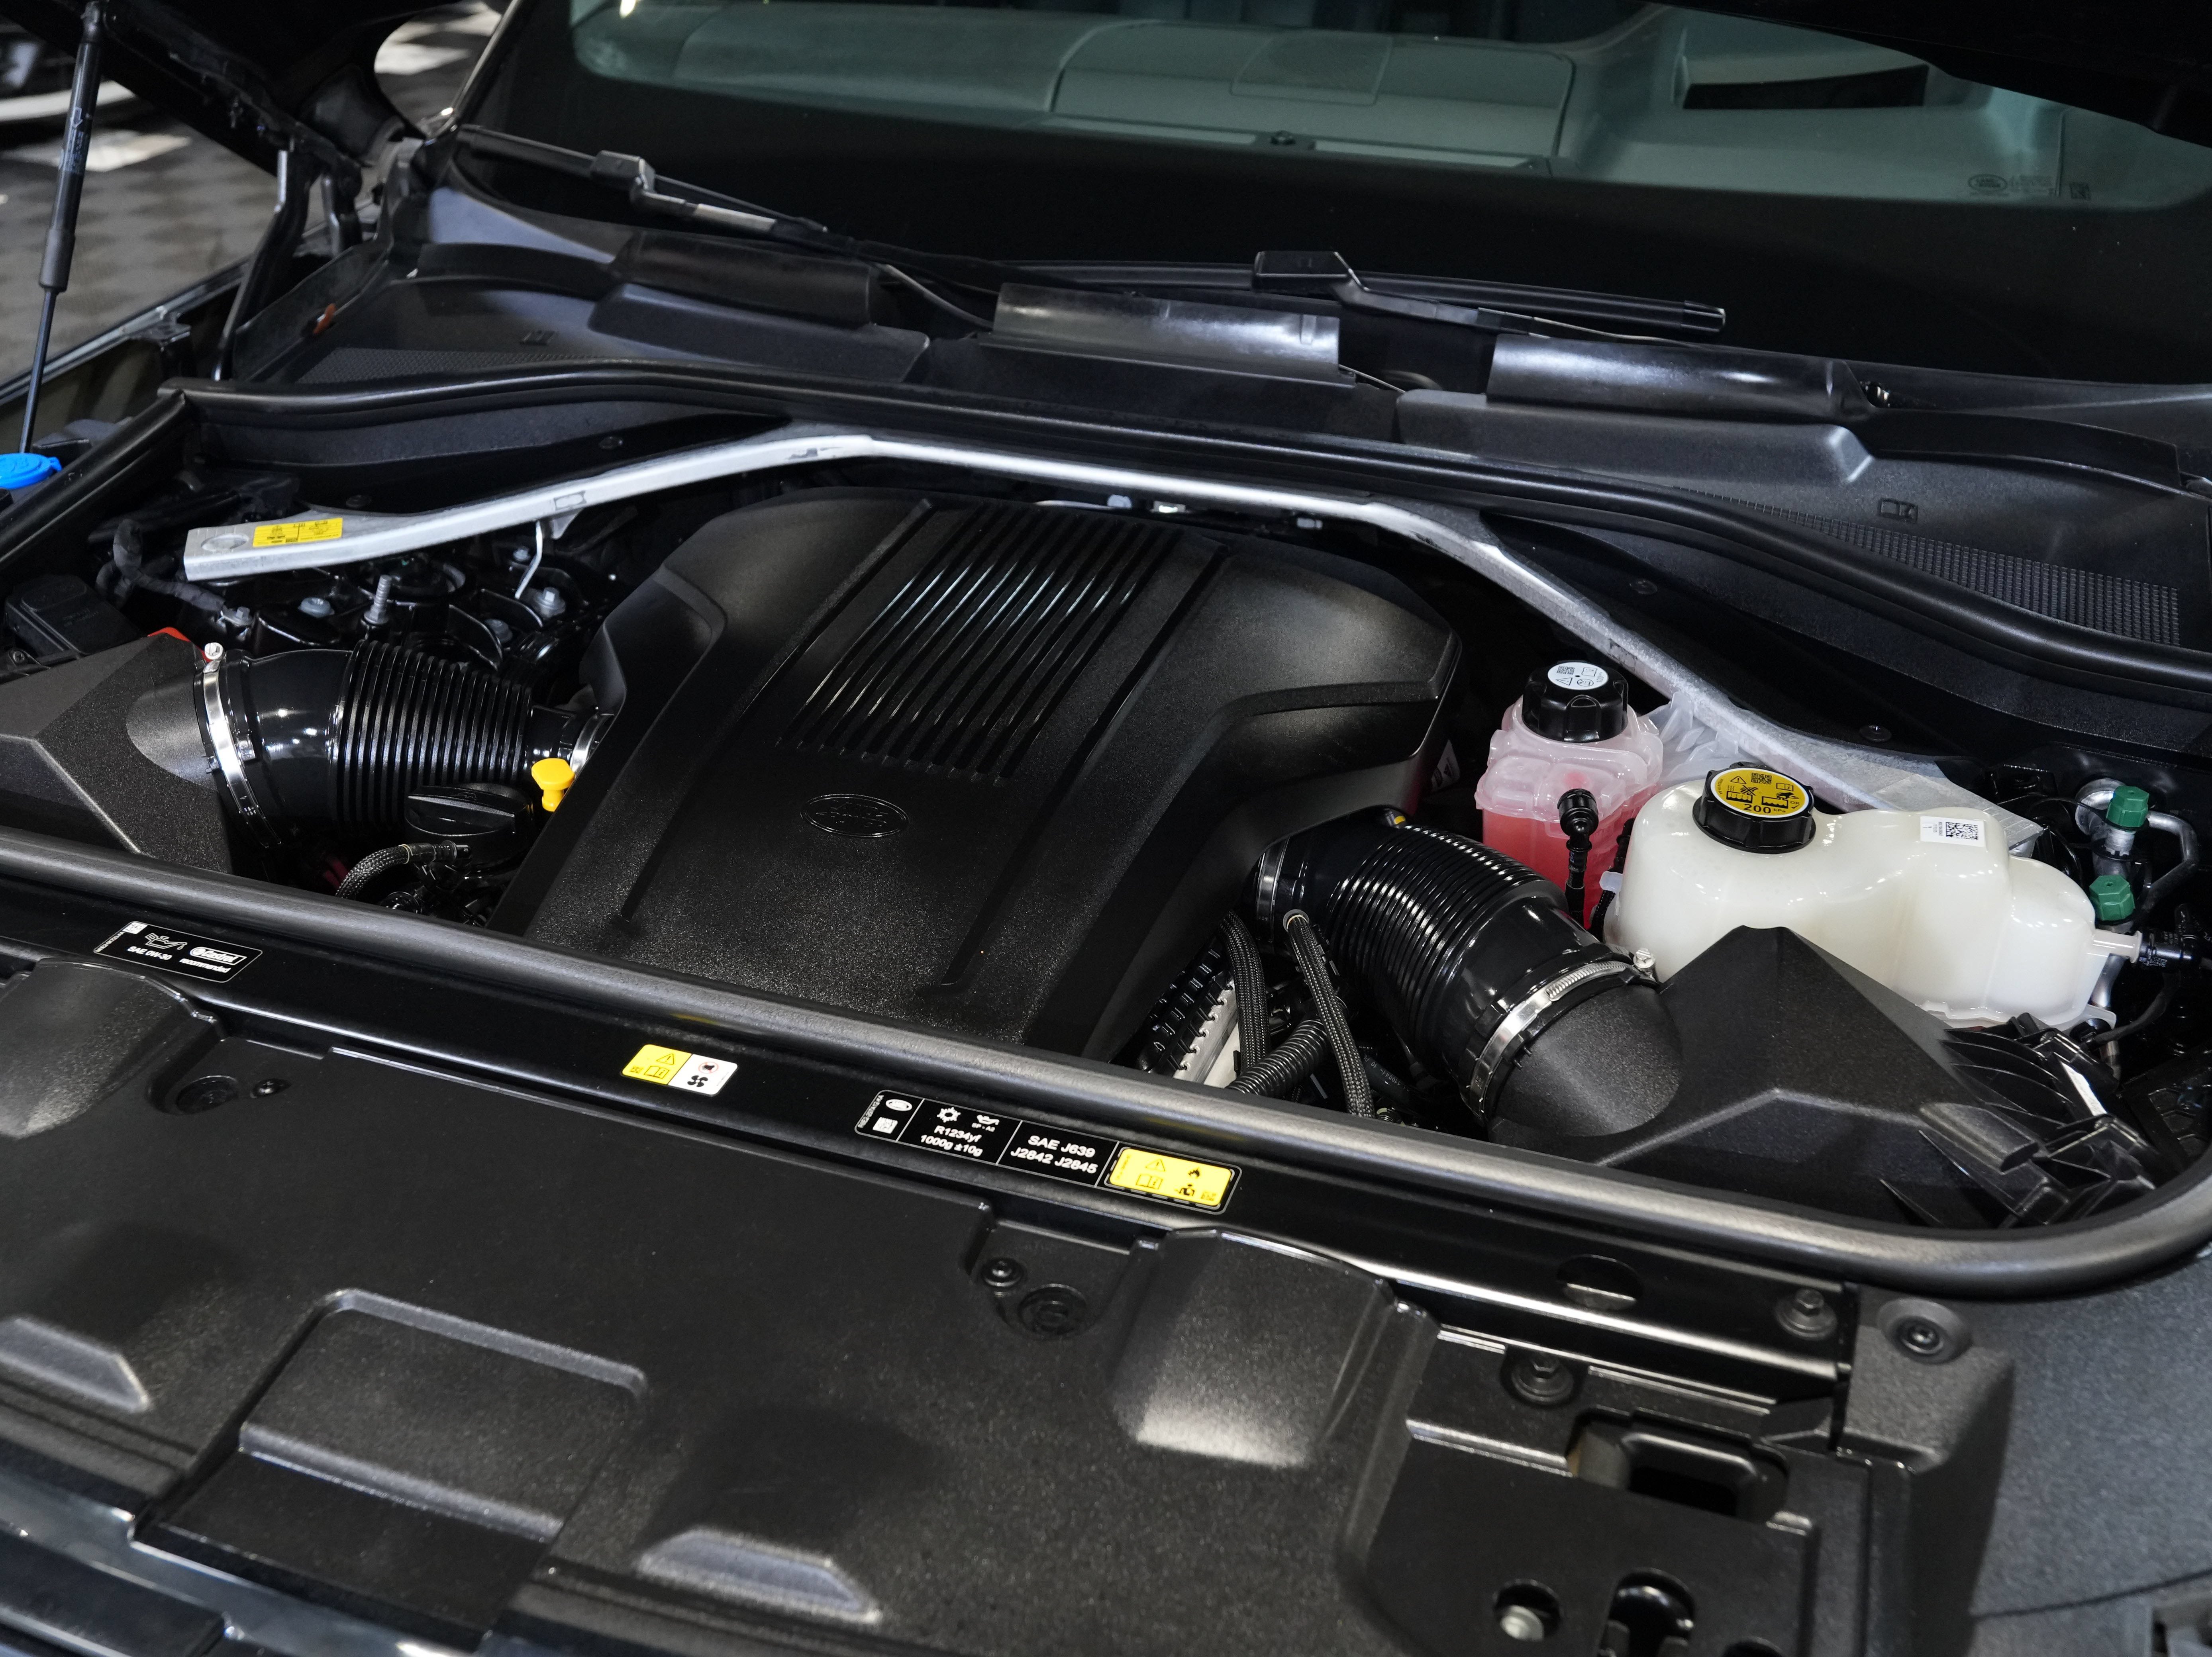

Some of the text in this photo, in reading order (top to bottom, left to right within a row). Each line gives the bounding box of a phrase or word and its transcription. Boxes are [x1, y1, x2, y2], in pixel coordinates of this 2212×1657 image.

[1743, 803, 1771, 814] 200
[127, 946, 173, 960] SAE 0W-30
[201, 950, 239, 963] Castrol
[179, 958, 231, 973] recommended
[934, 1125, 982, 1142] R1234yf
[921, 1134, 983, 1157] 1000g ±10g
[1028, 1135, 1096, 1158] SAE J639
[1010, 1147, 1054, 1164] J2842
[1054, 1157, 1098, 1174] J2845
